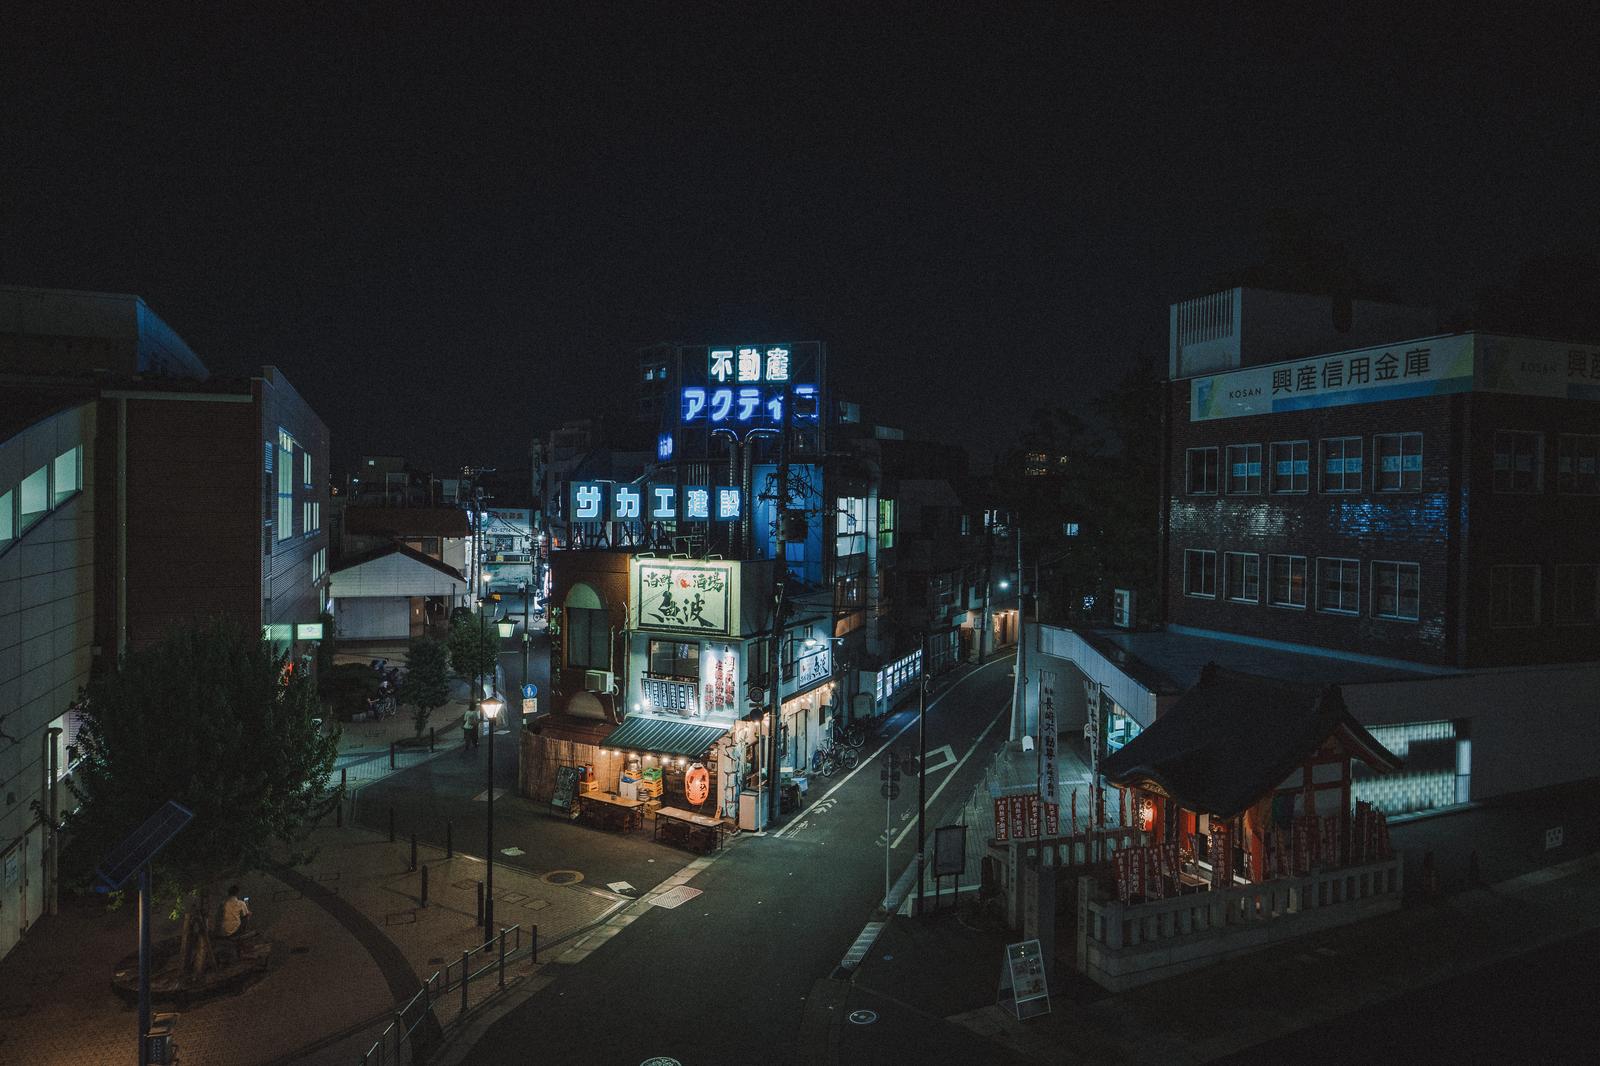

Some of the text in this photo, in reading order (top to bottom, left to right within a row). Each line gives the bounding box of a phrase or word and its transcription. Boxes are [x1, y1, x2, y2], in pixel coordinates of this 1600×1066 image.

[711, 348, 789, 382] 不動産
[1271, 348, 1432, 396] 興産信用金庫
[684, 387, 815, 421] アクティ
[1229, 387, 1262, 400] KOSAN
[576, 486, 740, 518] サカエ建設
[643, 571, 725, 593] 海鮮 酒場
[648, 591, 718, 628] 魚波
